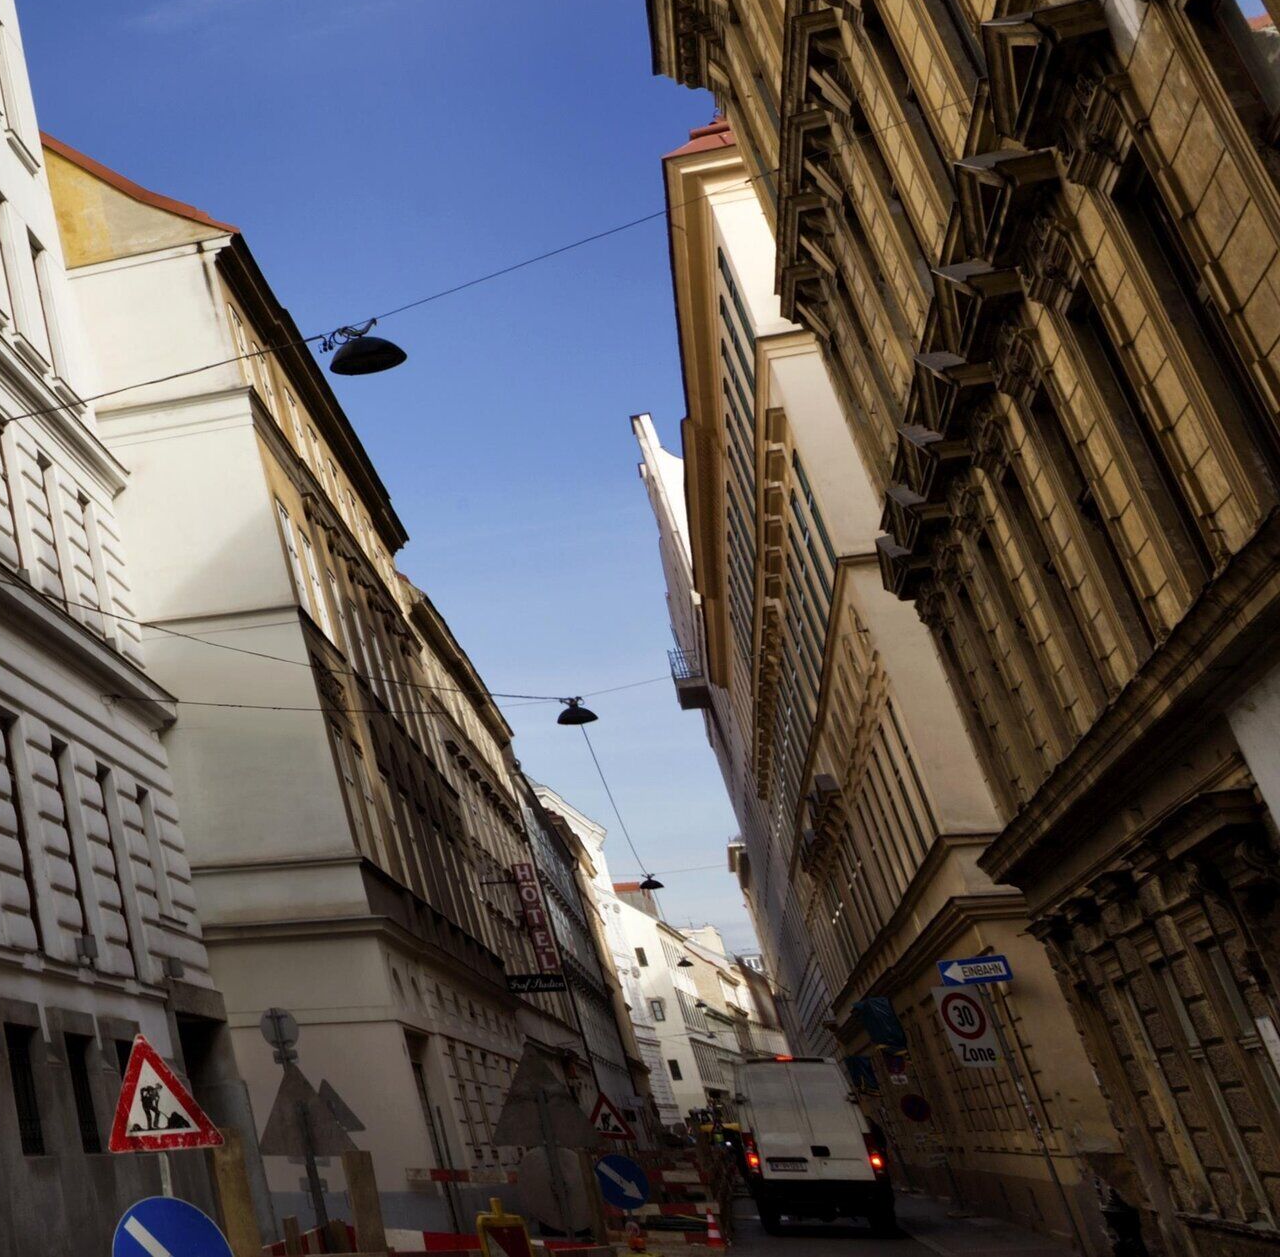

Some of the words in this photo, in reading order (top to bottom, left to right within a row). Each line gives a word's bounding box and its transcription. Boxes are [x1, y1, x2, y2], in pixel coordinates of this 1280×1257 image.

[515, 865, 555, 970] HOTEL
[961, 962, 1003, 977] EINBAHN
[953, 1005, 975, 1027] 30
[959, 1044, 997, 1062] Zone
